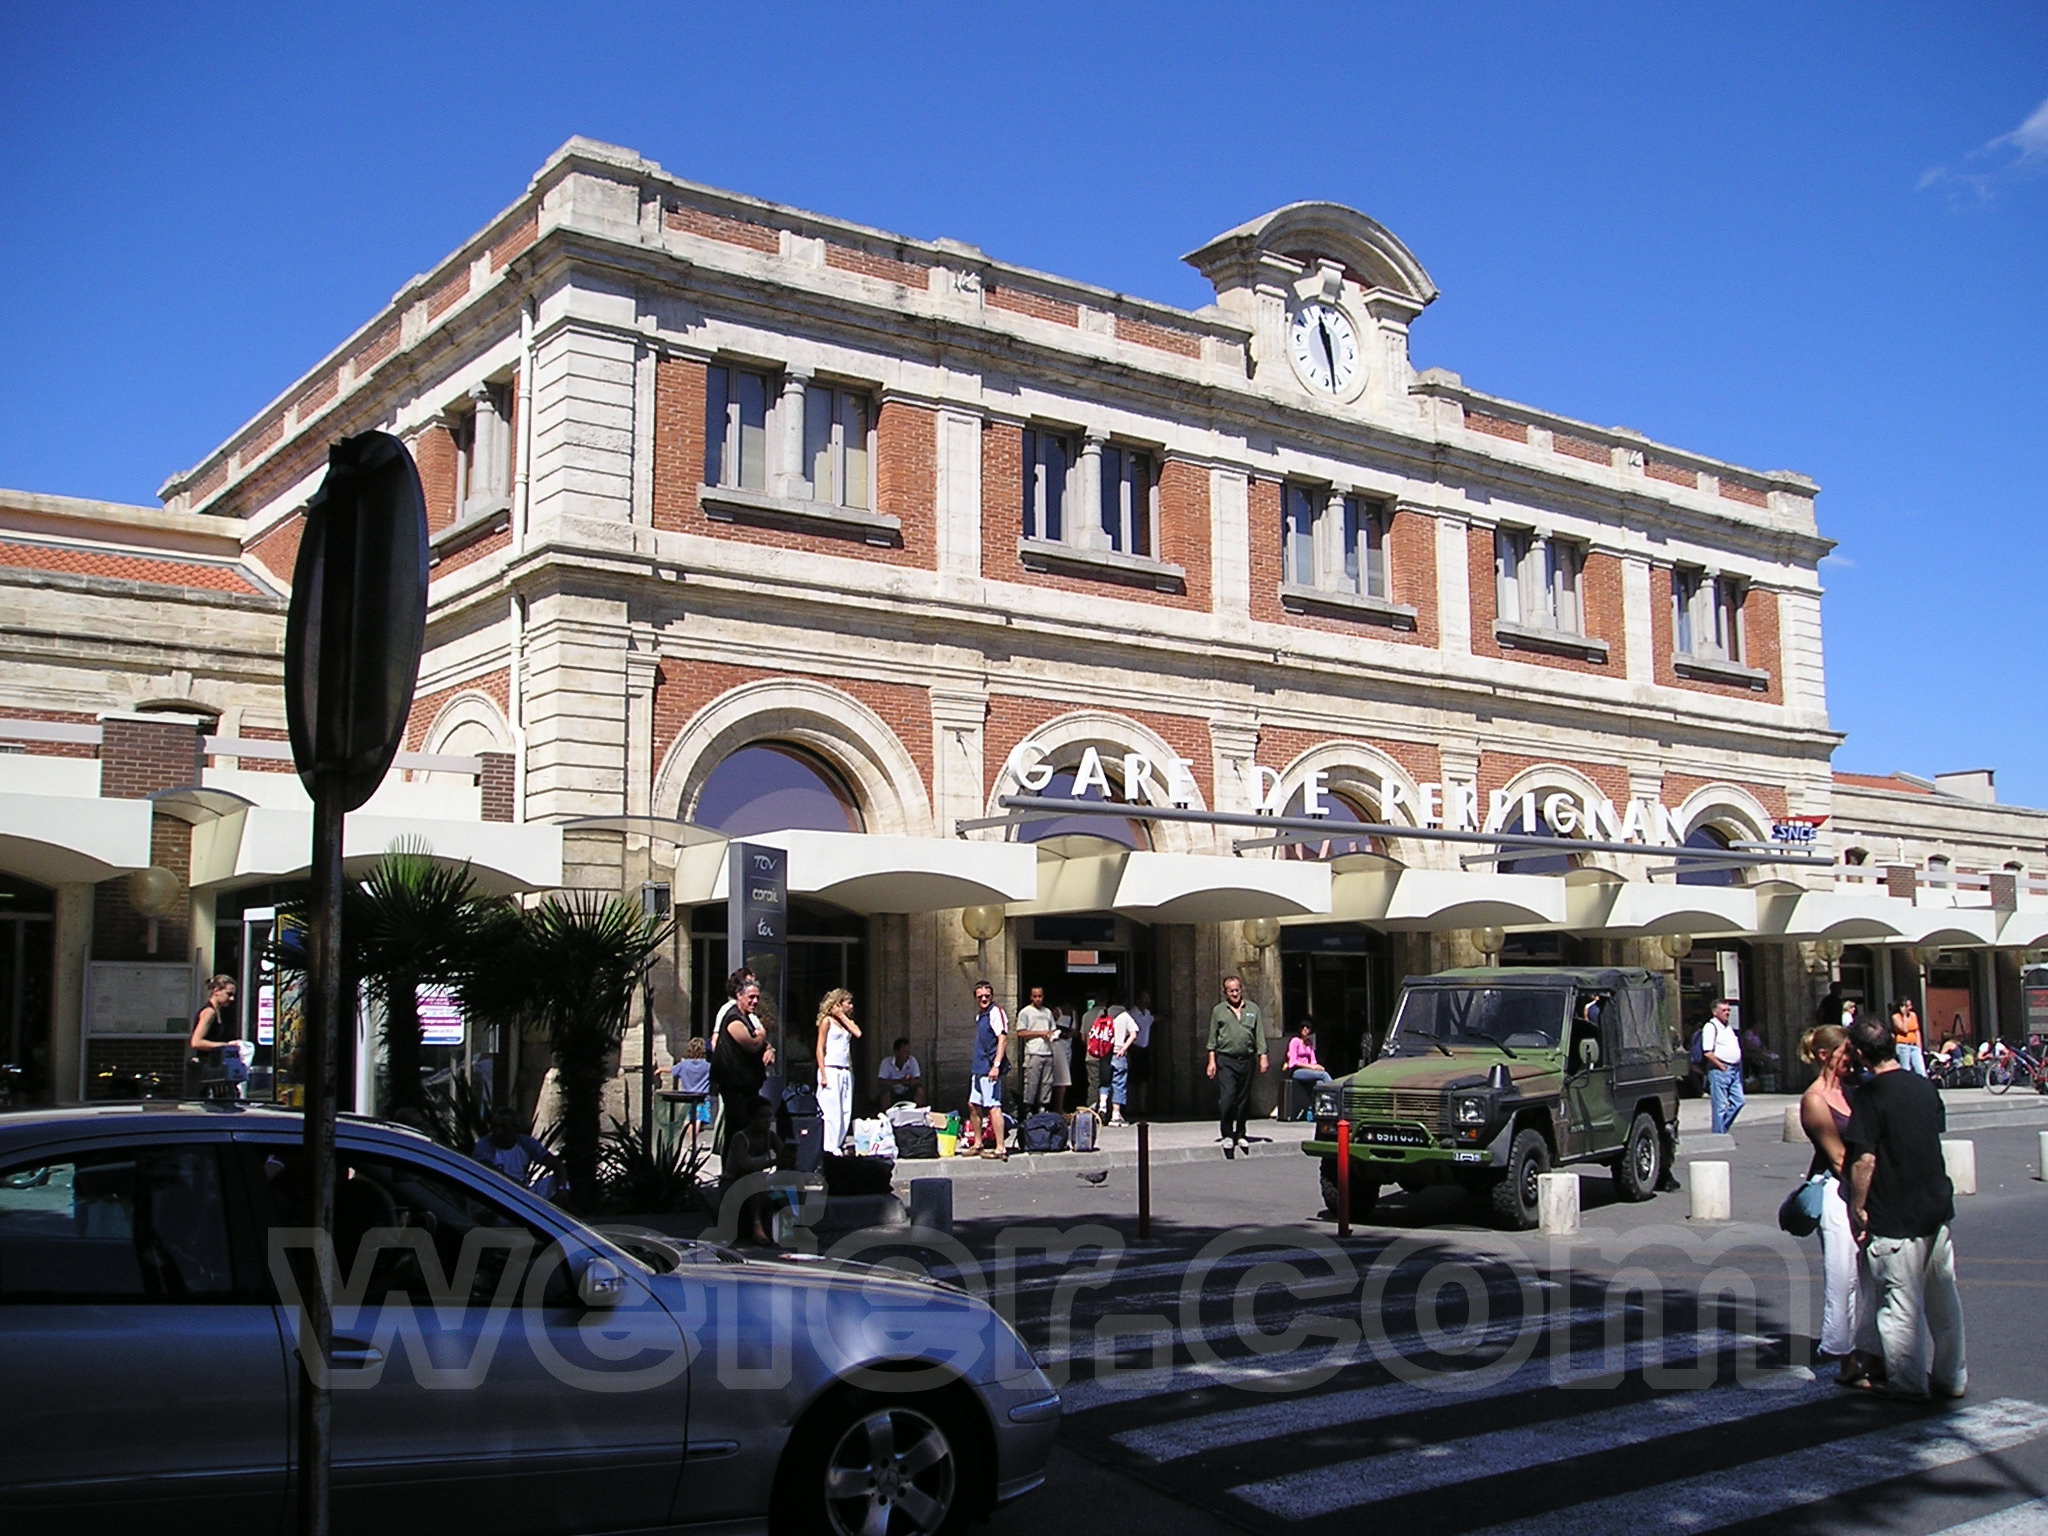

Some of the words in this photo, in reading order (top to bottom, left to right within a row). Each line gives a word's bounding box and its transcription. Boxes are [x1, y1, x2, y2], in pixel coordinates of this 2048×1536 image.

[1009, 740, 1194, 803] GARE
[1252, 765, 1330, 815] DE
[1380, 778, 1686, 848] PERPIGNAN
[753, 854, 777, 870] TGV
[757, 917, 774, 937] ter
